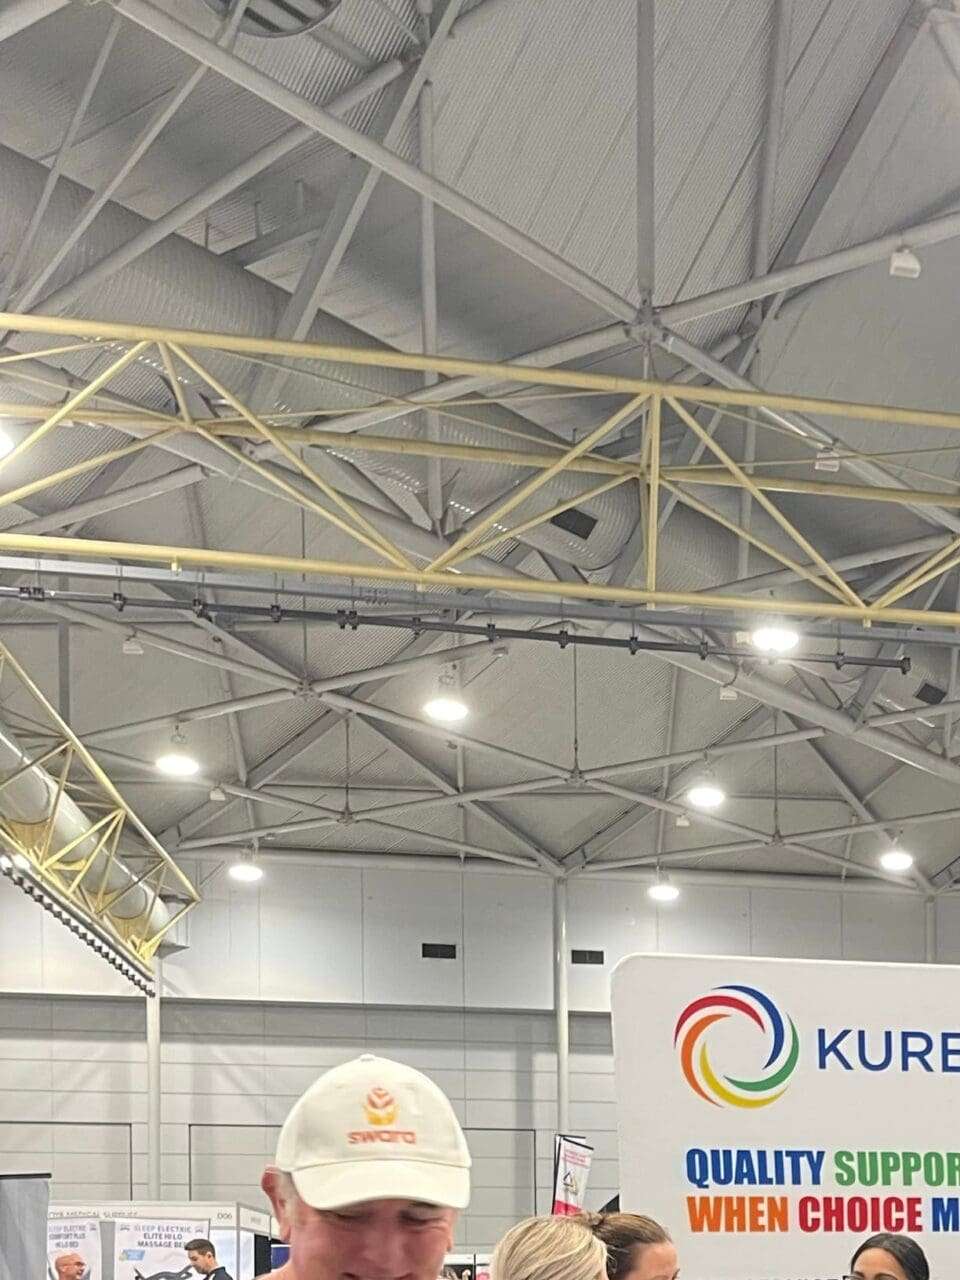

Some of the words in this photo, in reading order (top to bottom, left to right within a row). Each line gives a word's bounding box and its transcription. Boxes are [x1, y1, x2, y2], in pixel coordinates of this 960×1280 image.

[686, 1148, 825, 1189] QUALITY
[686, 1196, 789, 1232] WHEN
[799, 1196, 923, 1233] CHOICE
